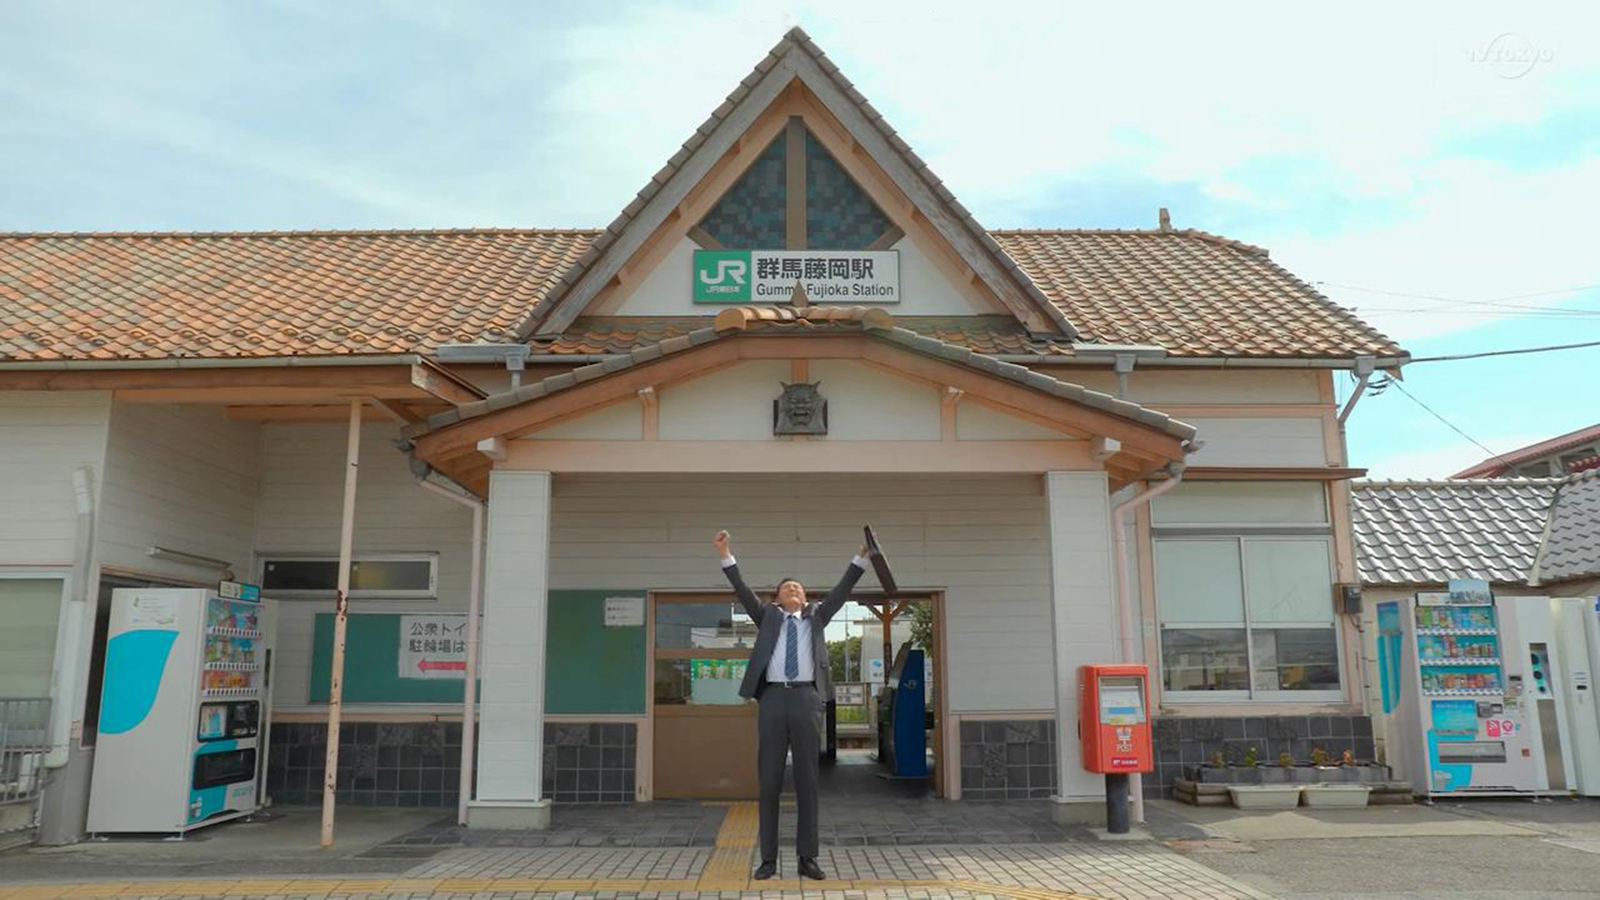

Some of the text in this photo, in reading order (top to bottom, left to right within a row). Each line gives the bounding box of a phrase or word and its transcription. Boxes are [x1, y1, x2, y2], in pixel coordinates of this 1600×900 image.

[700, 260, 746, 284] JR
[756, 257, 874, 280] 群馬藤岡駅
[852, 283, 894, 296] Station
[409, 638, 466, 654] 駐輪場は
[1117, 744, 1132, 752] POST
